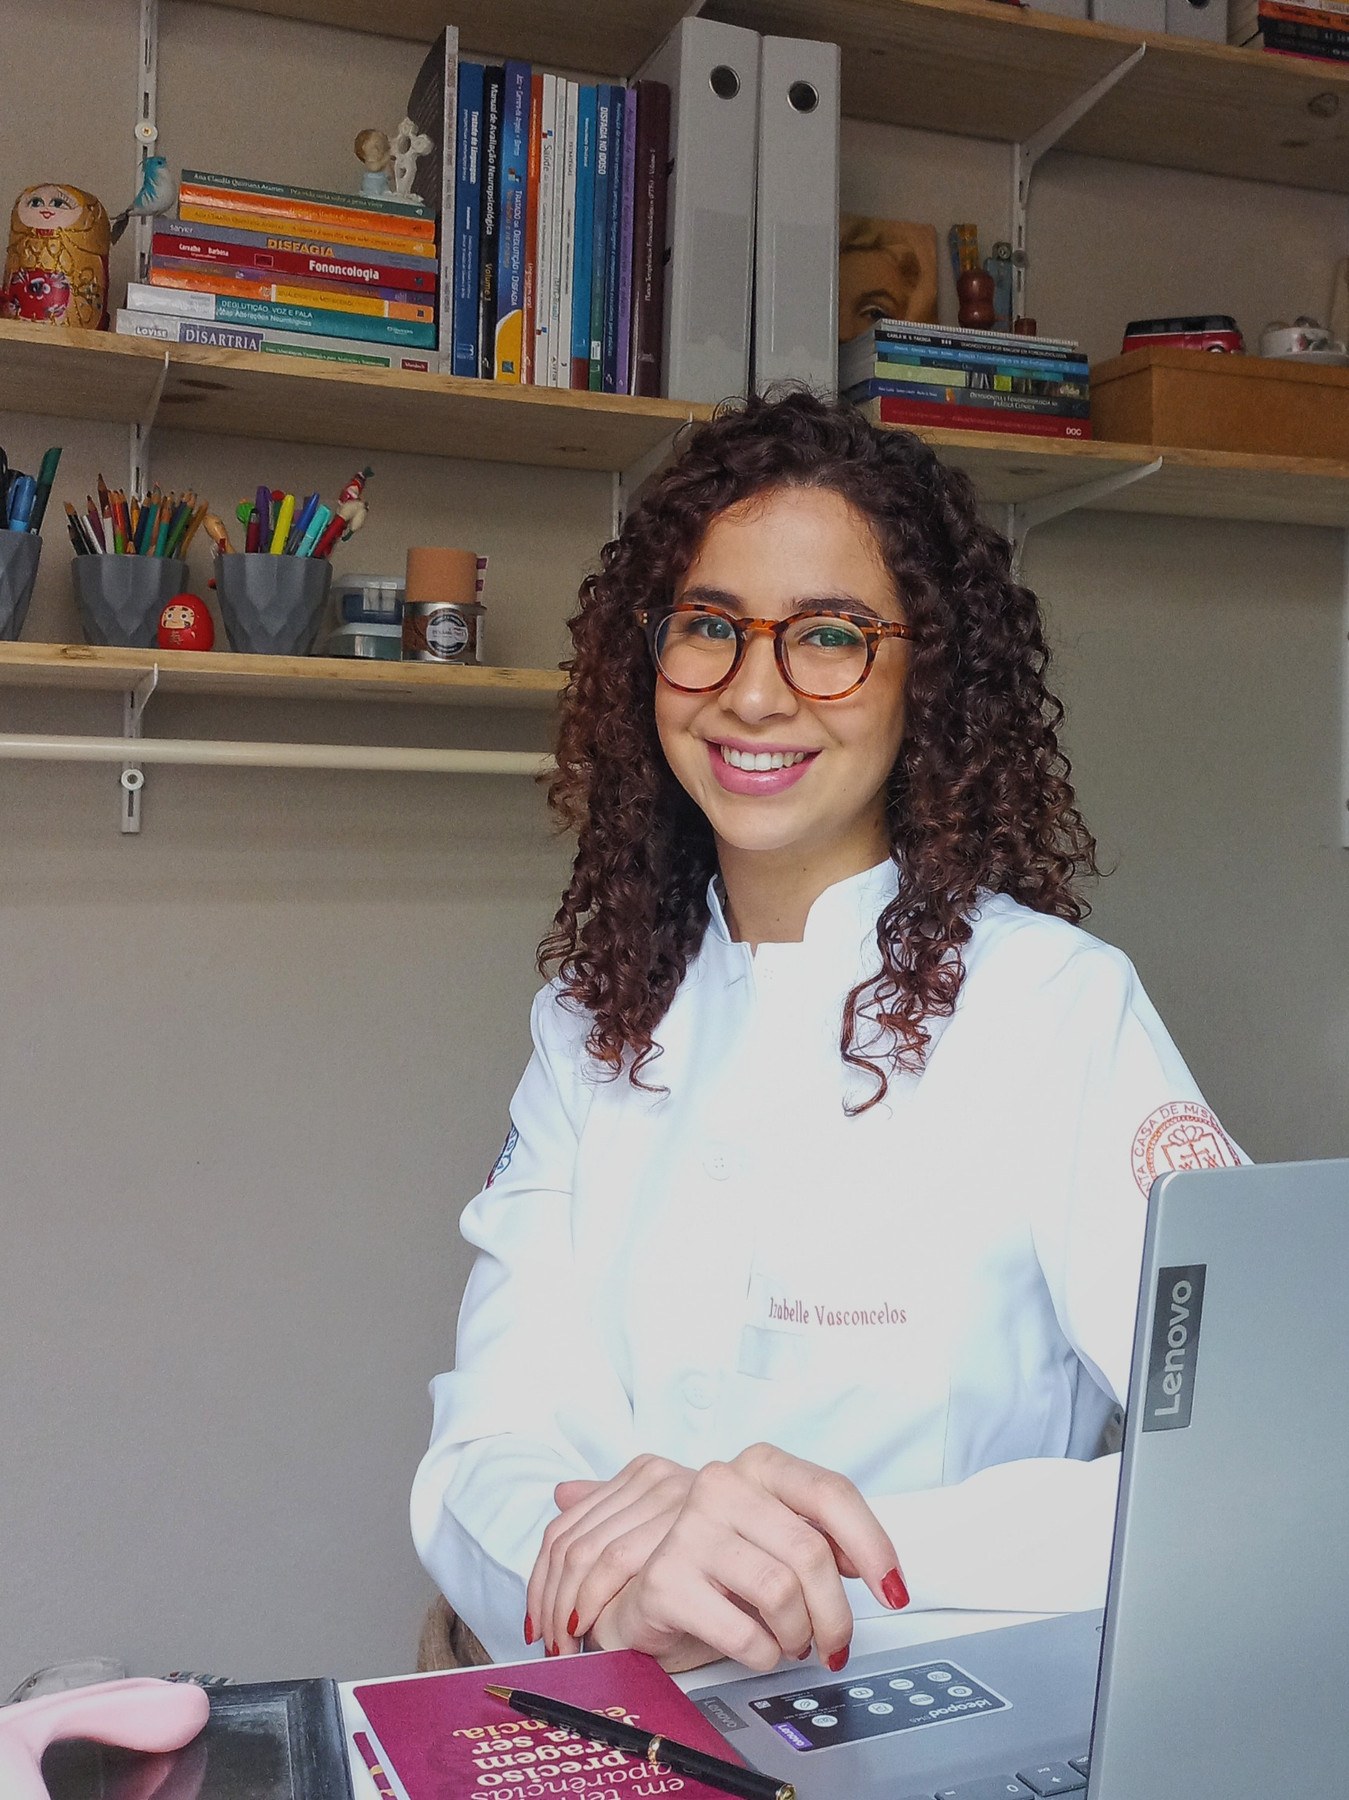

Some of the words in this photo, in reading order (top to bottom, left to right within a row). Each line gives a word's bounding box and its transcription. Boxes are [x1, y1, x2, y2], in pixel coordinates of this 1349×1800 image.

[490, 83, 499, 114] Manual
[489, 114, 498, 125] de
[600, 107, 609, 139] DISFAGIA
[487, 125, 497, 164] Avaliação
[543, 144, 552, 171] Saúde
[598, 140, 607, 152] NO
[598, 152, 607, 175] IDOSO
[485, 165, 496, 235] Neuropsicológica
[513, 190, 522, 220] TRATADO
[179, 243, 202, 253] Carvalho
[208, 247, 229, 257] Barbosa
[266, 238, 335, 257] DISFAGIA
[511, 229, 522, 271] DEGLUTIÇÃO
[309, 260, 380, 281] Fononcologia
[484, 263, 494, 295] Volume
[510, 276, 520, 306] DISFAGIA
[272, 306, 287, 315] VOZ
[294, 309, 313, 319] FALA
[185, 329, 258, 351] DISARTRIA
[1066, 427, 1082, 436] DOC
[1134, 1119, 1159, 1157] CASA
[1160, 1104, 1180, 1119] DE
[768, 1297, 809, 1324] Izabelle
[814, 1302, 907, 1326] Vasconcelos
[1154, 1280, 1192, 1416] Lenovo
[703, 1699, 737, 1728] Lenovo
[471, 1736, 534, 1755] ser
[777, 1724, 805, 1747] Lenovo
[476, 1750, 630, 1787] preciso
[631, 1777, 685, 1796] em
